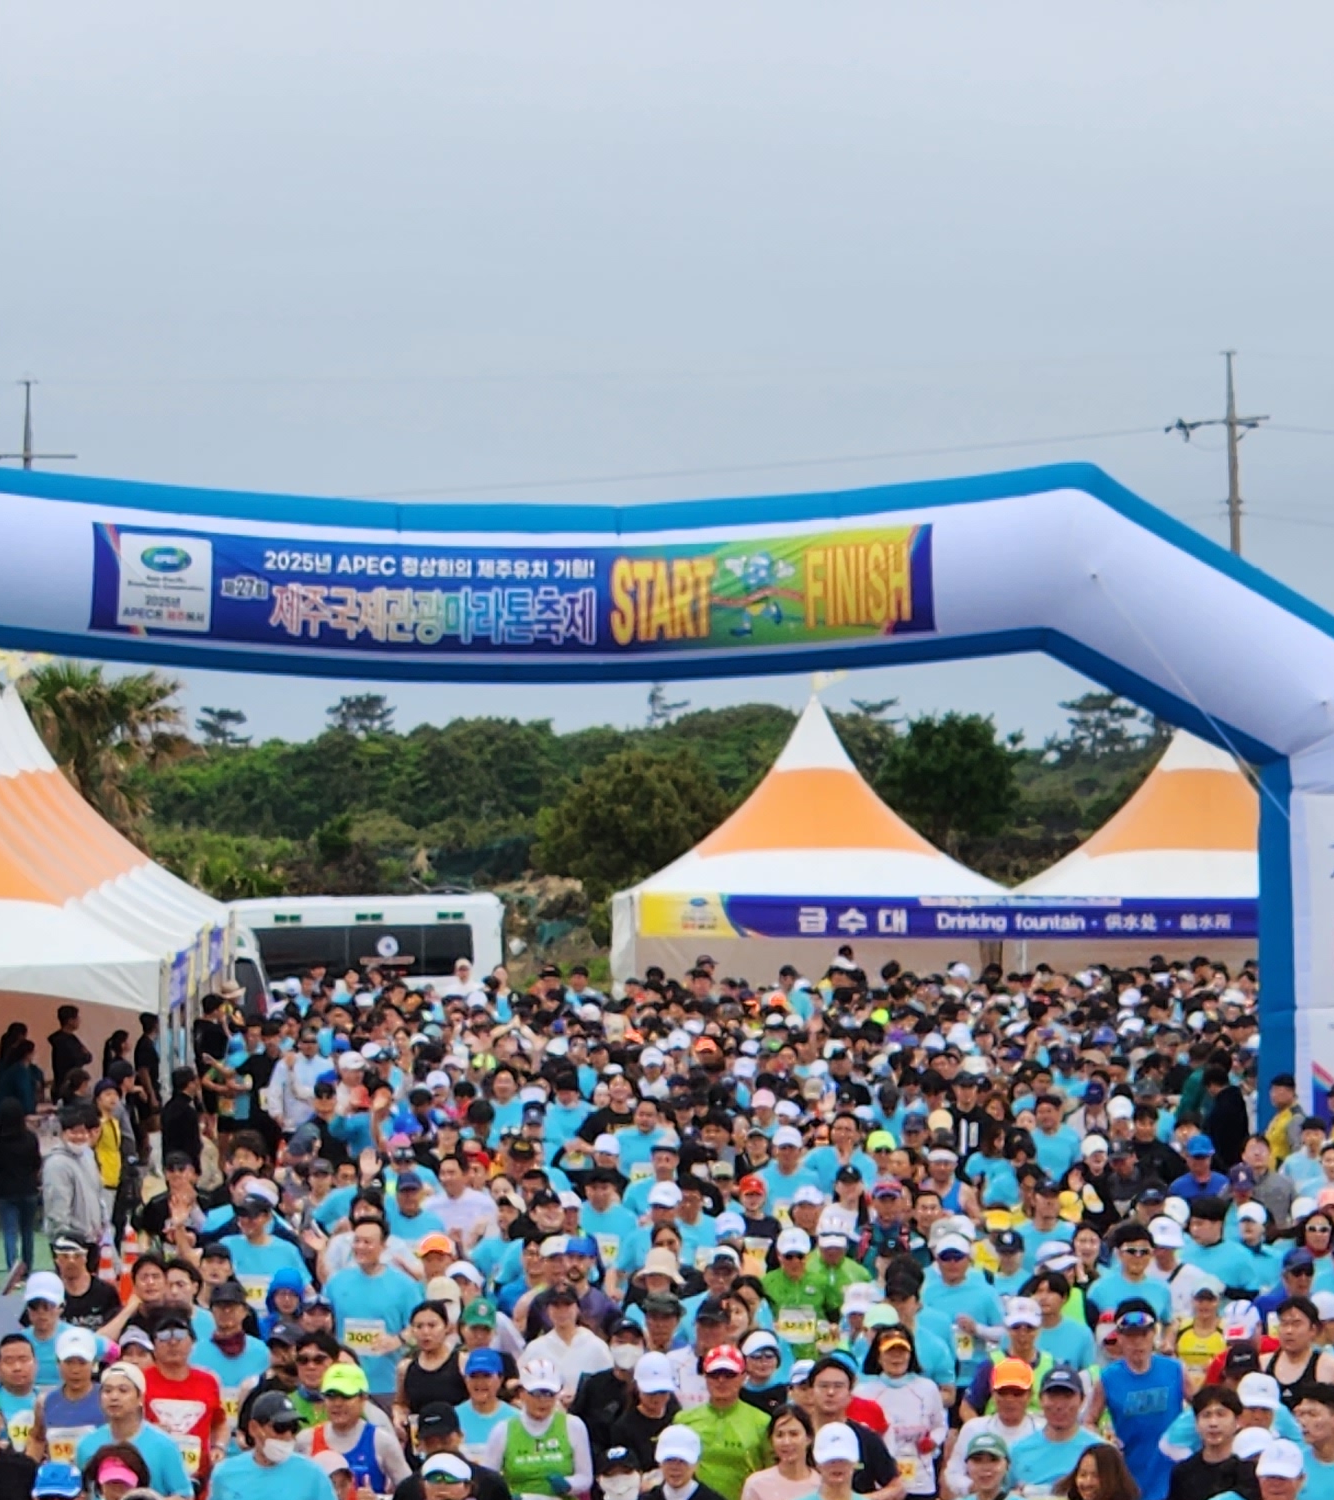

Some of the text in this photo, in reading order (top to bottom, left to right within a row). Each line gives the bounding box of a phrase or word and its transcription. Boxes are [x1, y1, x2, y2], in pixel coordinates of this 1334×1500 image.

[222, 576, 267, 599] 제27회
[264, 549, 596, 580] 2025년 APEC 정상회의 제주유치 기원!
[804, 542, 912, 628] FINISH
[270, 583, 597, 645] 제주국제관광마라톤축제
[610, 556, 716, 646] START
[936, 912, 1086, 932] Drinking fountain
